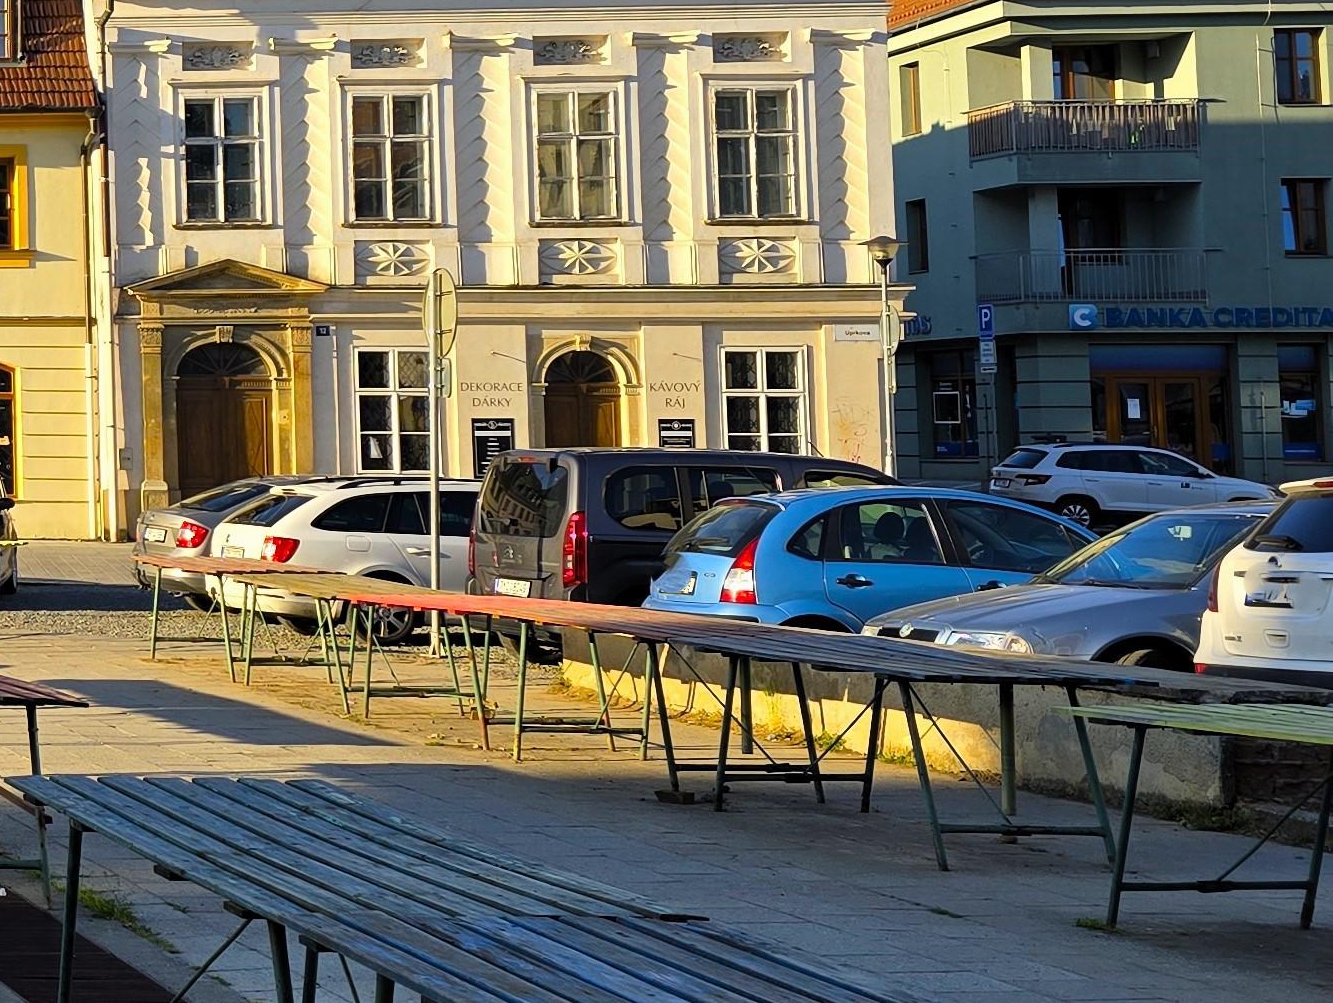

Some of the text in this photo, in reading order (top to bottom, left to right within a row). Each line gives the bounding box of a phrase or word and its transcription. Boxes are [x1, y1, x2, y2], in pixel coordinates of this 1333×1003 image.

[1104, 307, 1208, 328] BANKA
[460, 382, 523, 392] DEKORACE
[649, 380, 701, 392] KÁVOVÝ
[472, 395, 512, 407] DÁRKY
[665, 396, 685, 409] RÁJ
